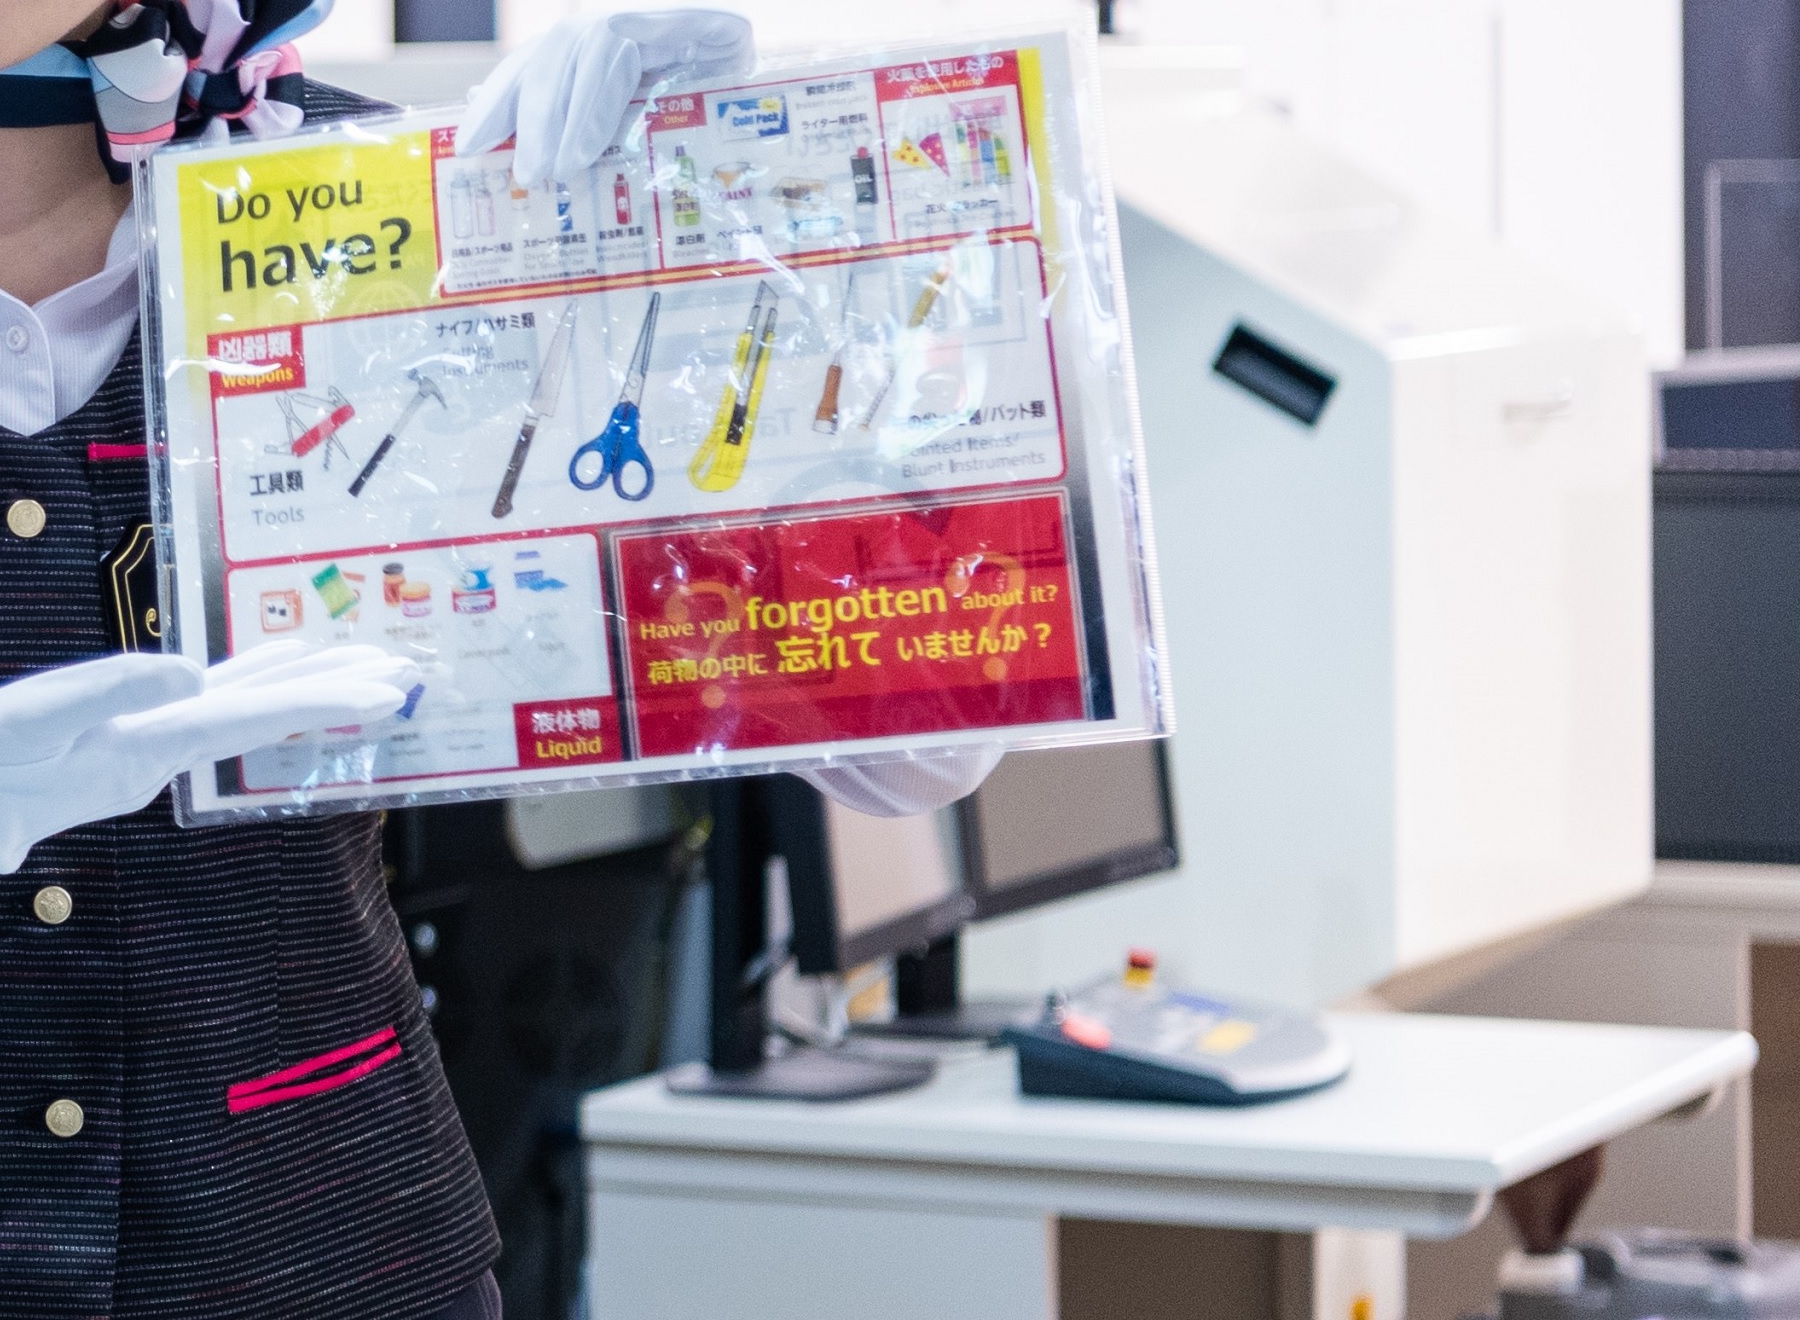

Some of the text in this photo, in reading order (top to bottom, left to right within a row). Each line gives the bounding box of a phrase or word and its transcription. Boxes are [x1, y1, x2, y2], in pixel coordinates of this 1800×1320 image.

[217, 179, 363, 224] Do you
[220, 217, 412, 293] have?
[218, 330, 293, 362] 凶器類
[442, 345, 493, 366] tting
[221, 366, 293, 389] Weapons
[443, 359, 529, 378] Instuments
[910, 438, 962, 458] ointed
[902, 451, 1046, 479] Blunt Instruments
[249, 470, 305, 497] 工具類
[252, 506, 305, 527] Tools
[640, 584, 1058, 641] Have you forgotten about it?
[647, 653, 768, 686] 荷物の中に
[776, 630, 882, 675] 忘れて
[532, 707, 602, 735] 液体物
[535, 736, 602, 761] Liquid
